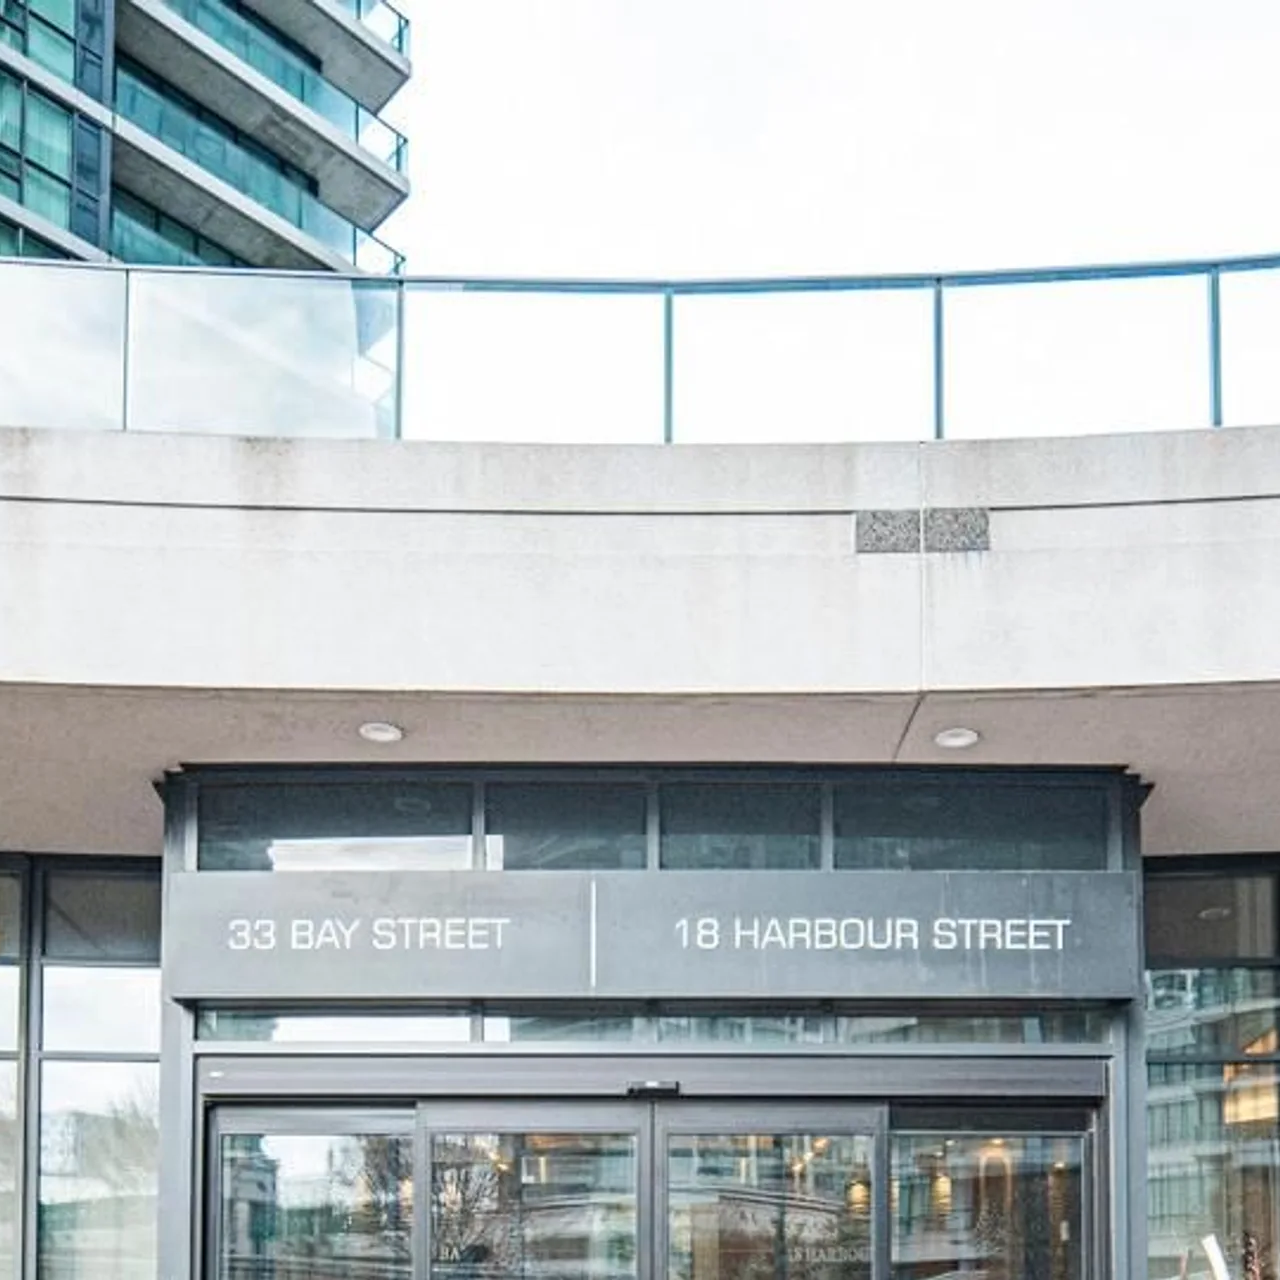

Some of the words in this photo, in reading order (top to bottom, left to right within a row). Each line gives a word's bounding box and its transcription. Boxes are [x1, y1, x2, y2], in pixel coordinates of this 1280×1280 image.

[228, 918, 277, 950] 33
[291, 918, 361, 950] BAY
[371, 916, 511, 950] STREET
[675, 917, 719, 950] 18
[734, 917, 919, 950] HARBOUR
[933, 917, 1071, 950] STREET
